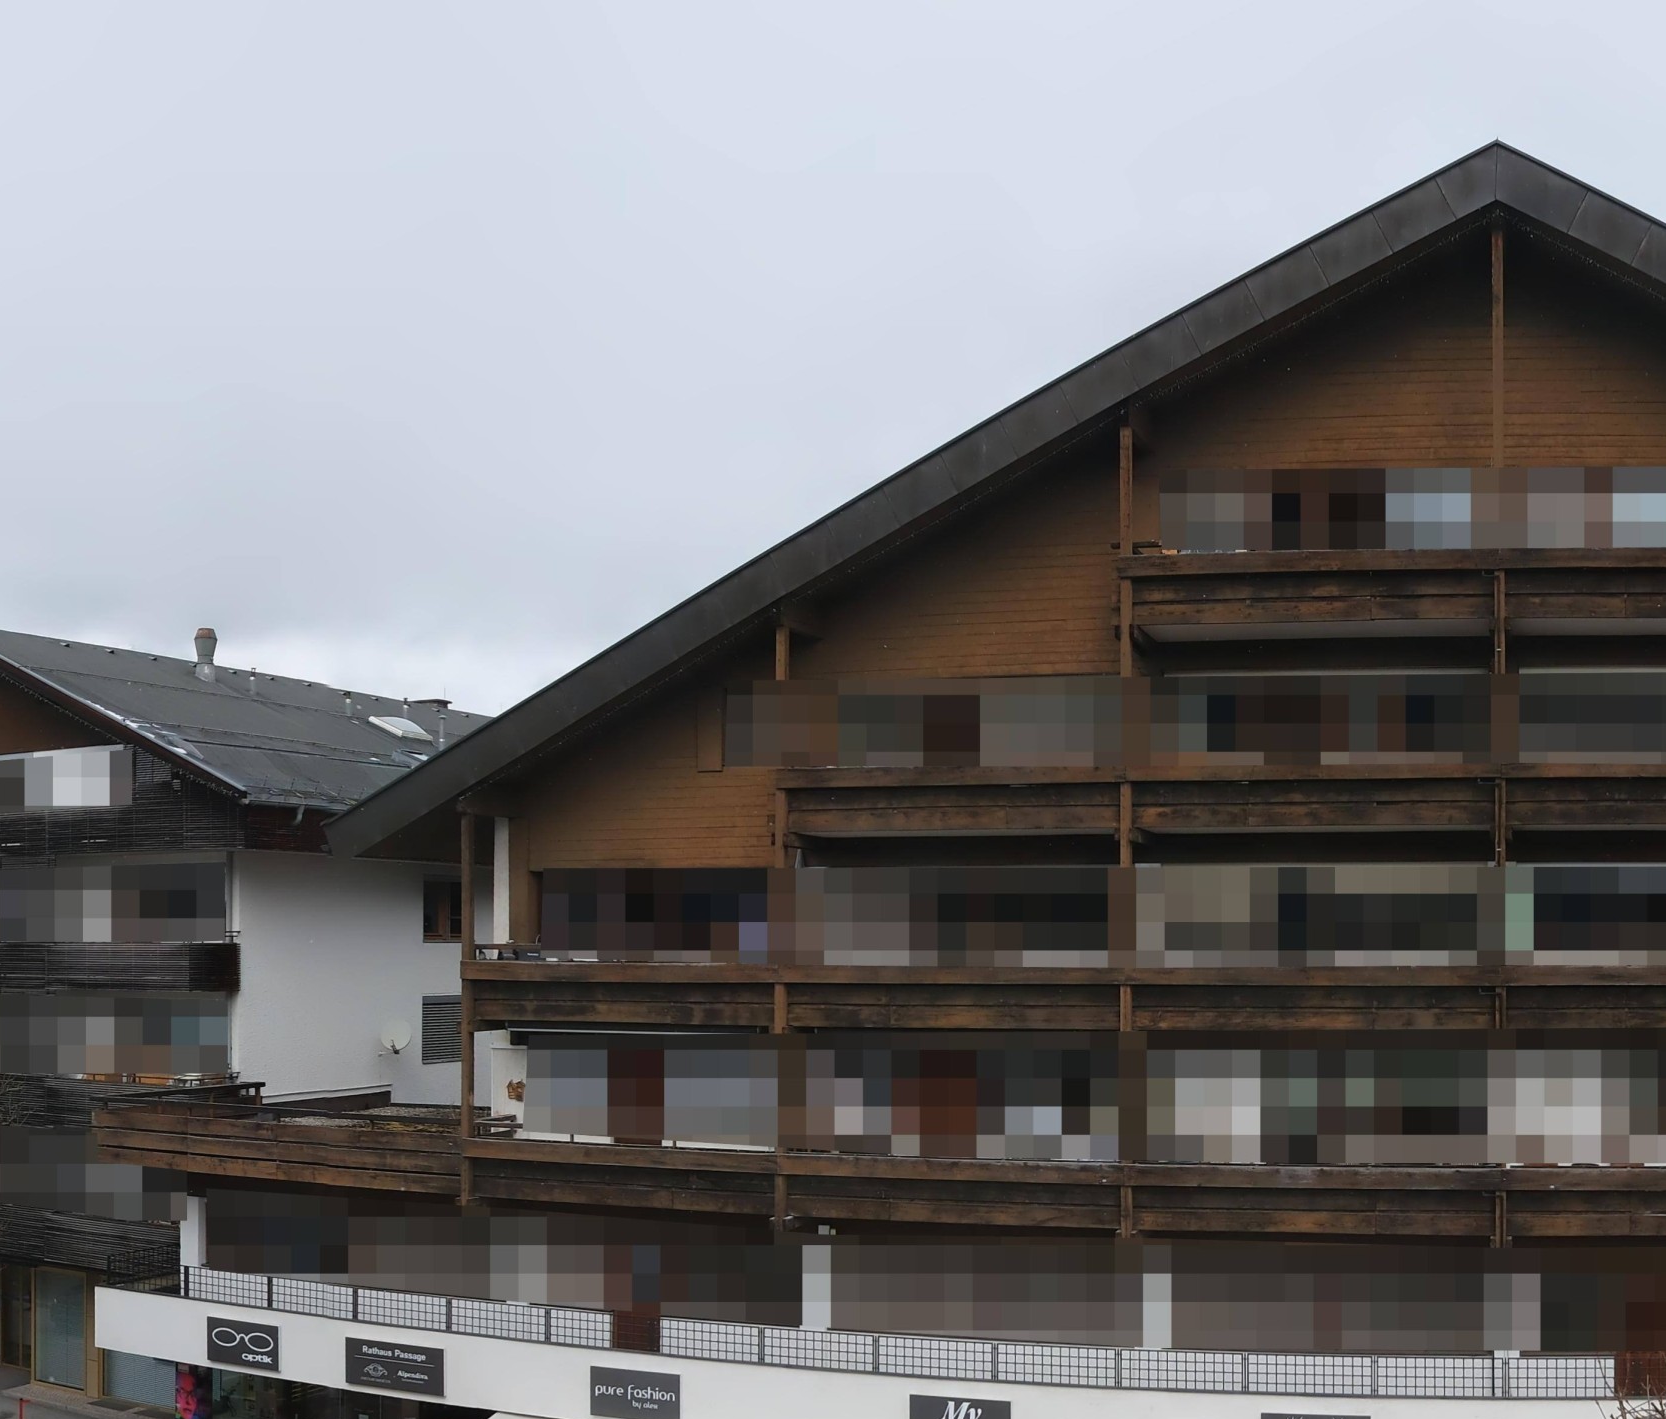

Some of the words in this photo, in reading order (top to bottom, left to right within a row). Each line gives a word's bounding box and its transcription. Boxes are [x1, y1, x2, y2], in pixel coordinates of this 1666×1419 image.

[241, 1352, 273, 1364] optik
[362, 1344, 392, 1357] Rathaus
[394, 1349, 426, 1362] Passage
[595, 1385, 624, 1397] pure
[627, 1384, 676, 1402] fashion
[632, 1400, 642, 1409] by
